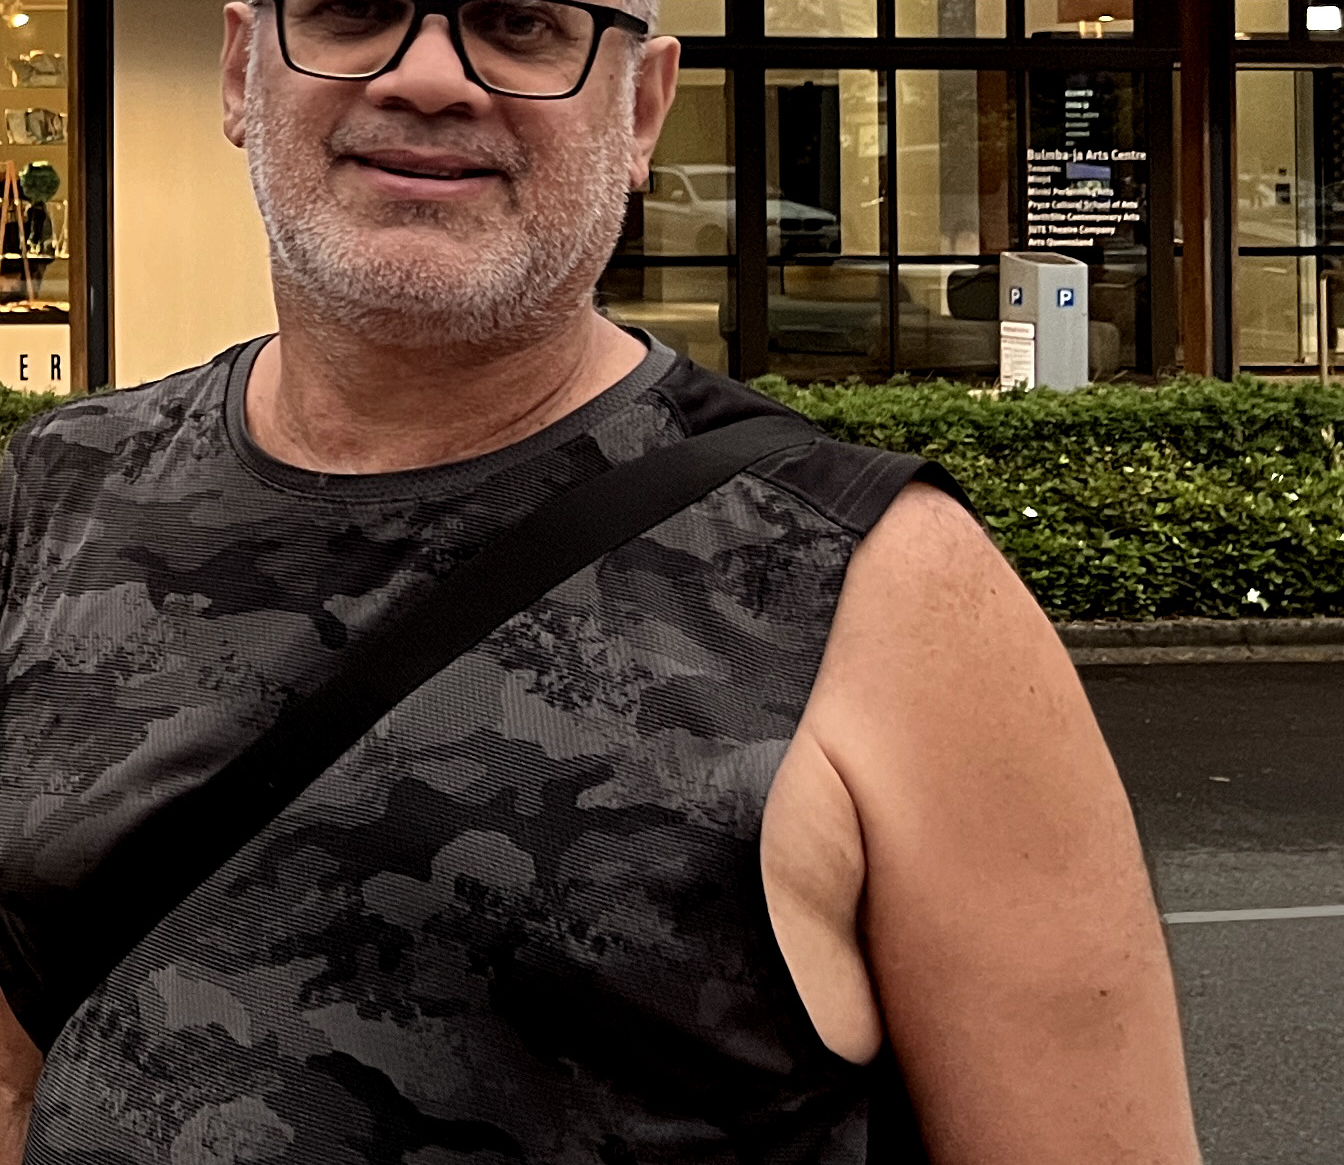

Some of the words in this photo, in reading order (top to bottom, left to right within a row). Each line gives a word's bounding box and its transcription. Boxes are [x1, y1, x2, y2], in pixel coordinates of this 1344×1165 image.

[1027, 149, 1083, 162] Bulmba-ja
[1086, 150, 1109, 160] Arts
[1111, 149, 1146, 160] Centre
[1011, 289, 1021, 305] P
[1059, 289, 1072, 307] P
